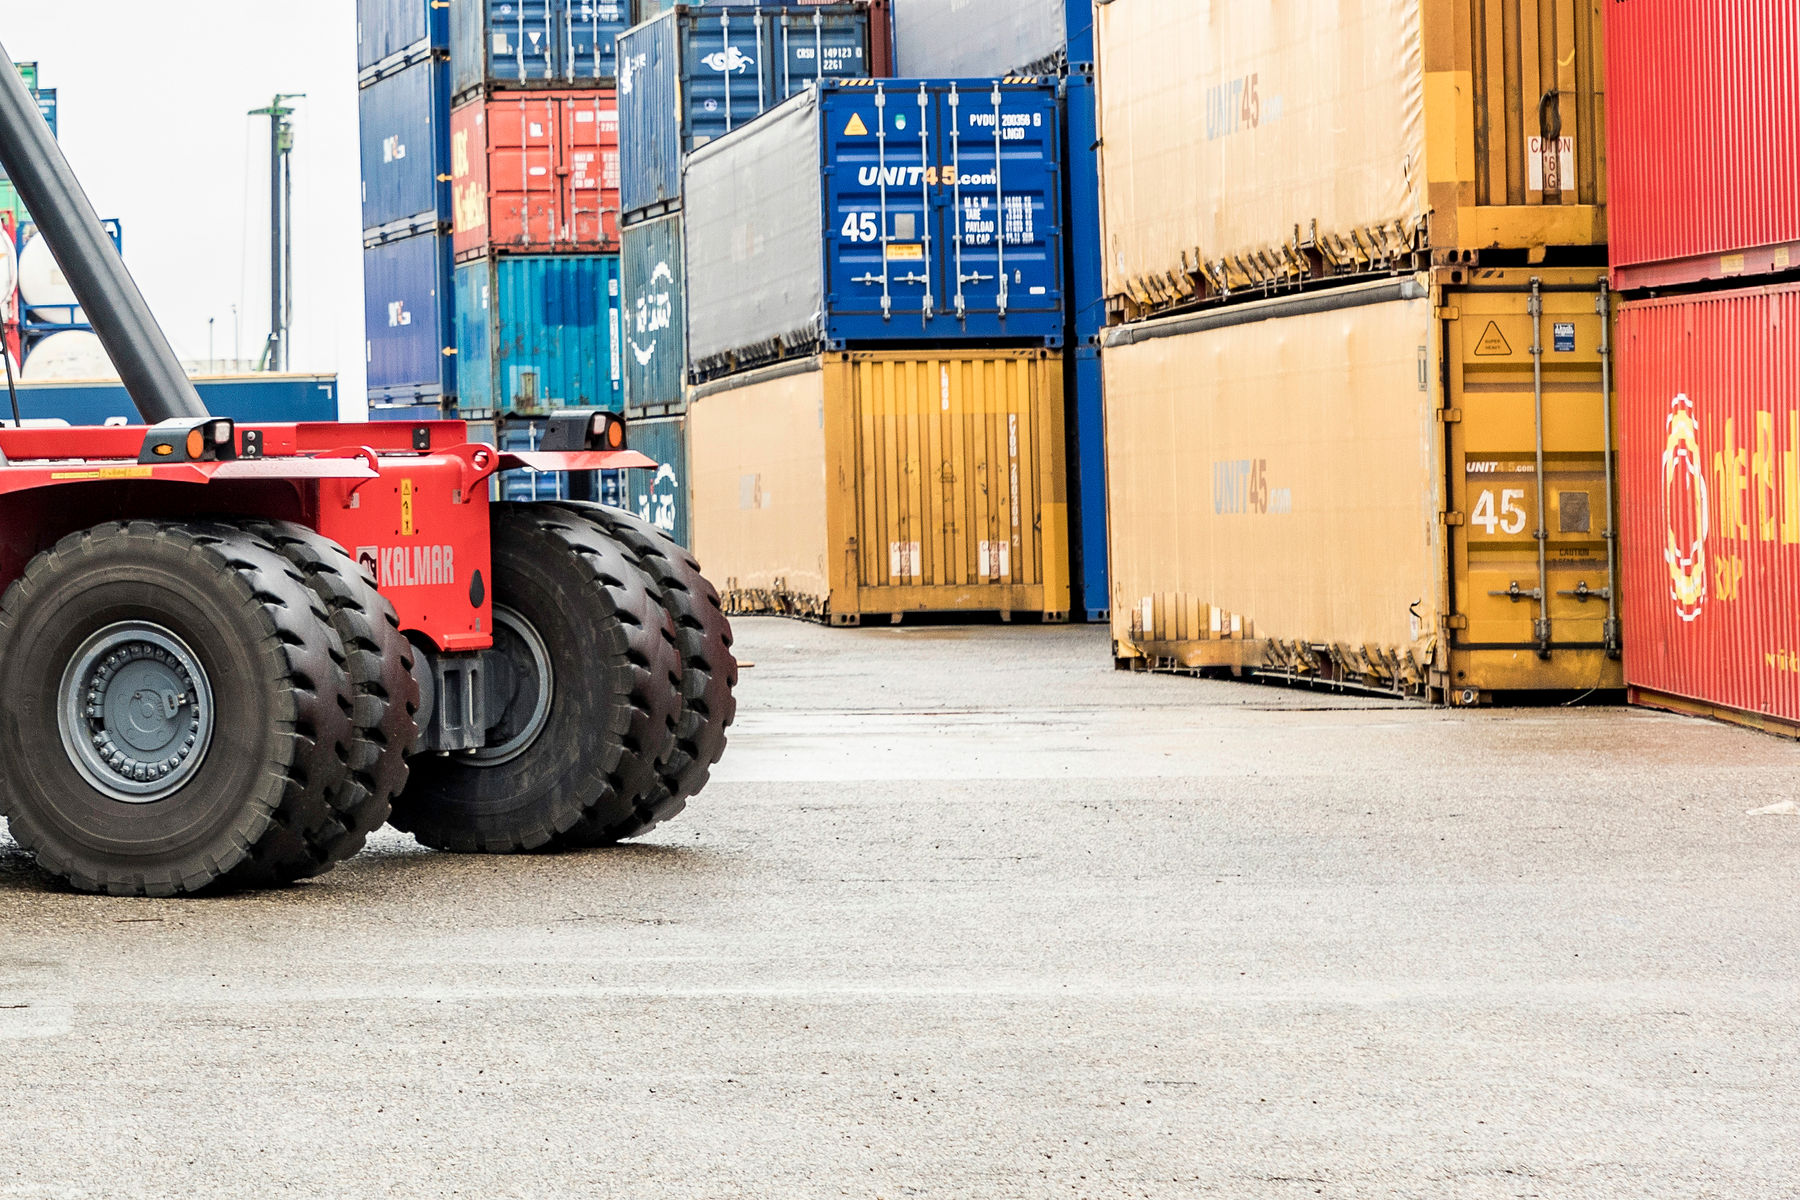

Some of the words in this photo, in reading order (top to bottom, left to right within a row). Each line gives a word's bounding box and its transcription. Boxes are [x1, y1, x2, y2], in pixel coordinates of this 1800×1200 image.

[796, 48, 815, 59] CRSU
[823, 48, 852, 58] 149123
[970, 114, 995, 127] PVDU
[1002, 128, 1025, 140] LNGD
[965, 208, 981, 220] TARE
[841, 212, 878, 242] 45
[965, 221, 994, 233] PAYLOAD
[1009, 414, 1017, 457] PVDU
[1471, 489, 1527, 535] 45
[1559, 548, 1590, 557] CAUTION
[381, 545, 454, 588] KALMAR
